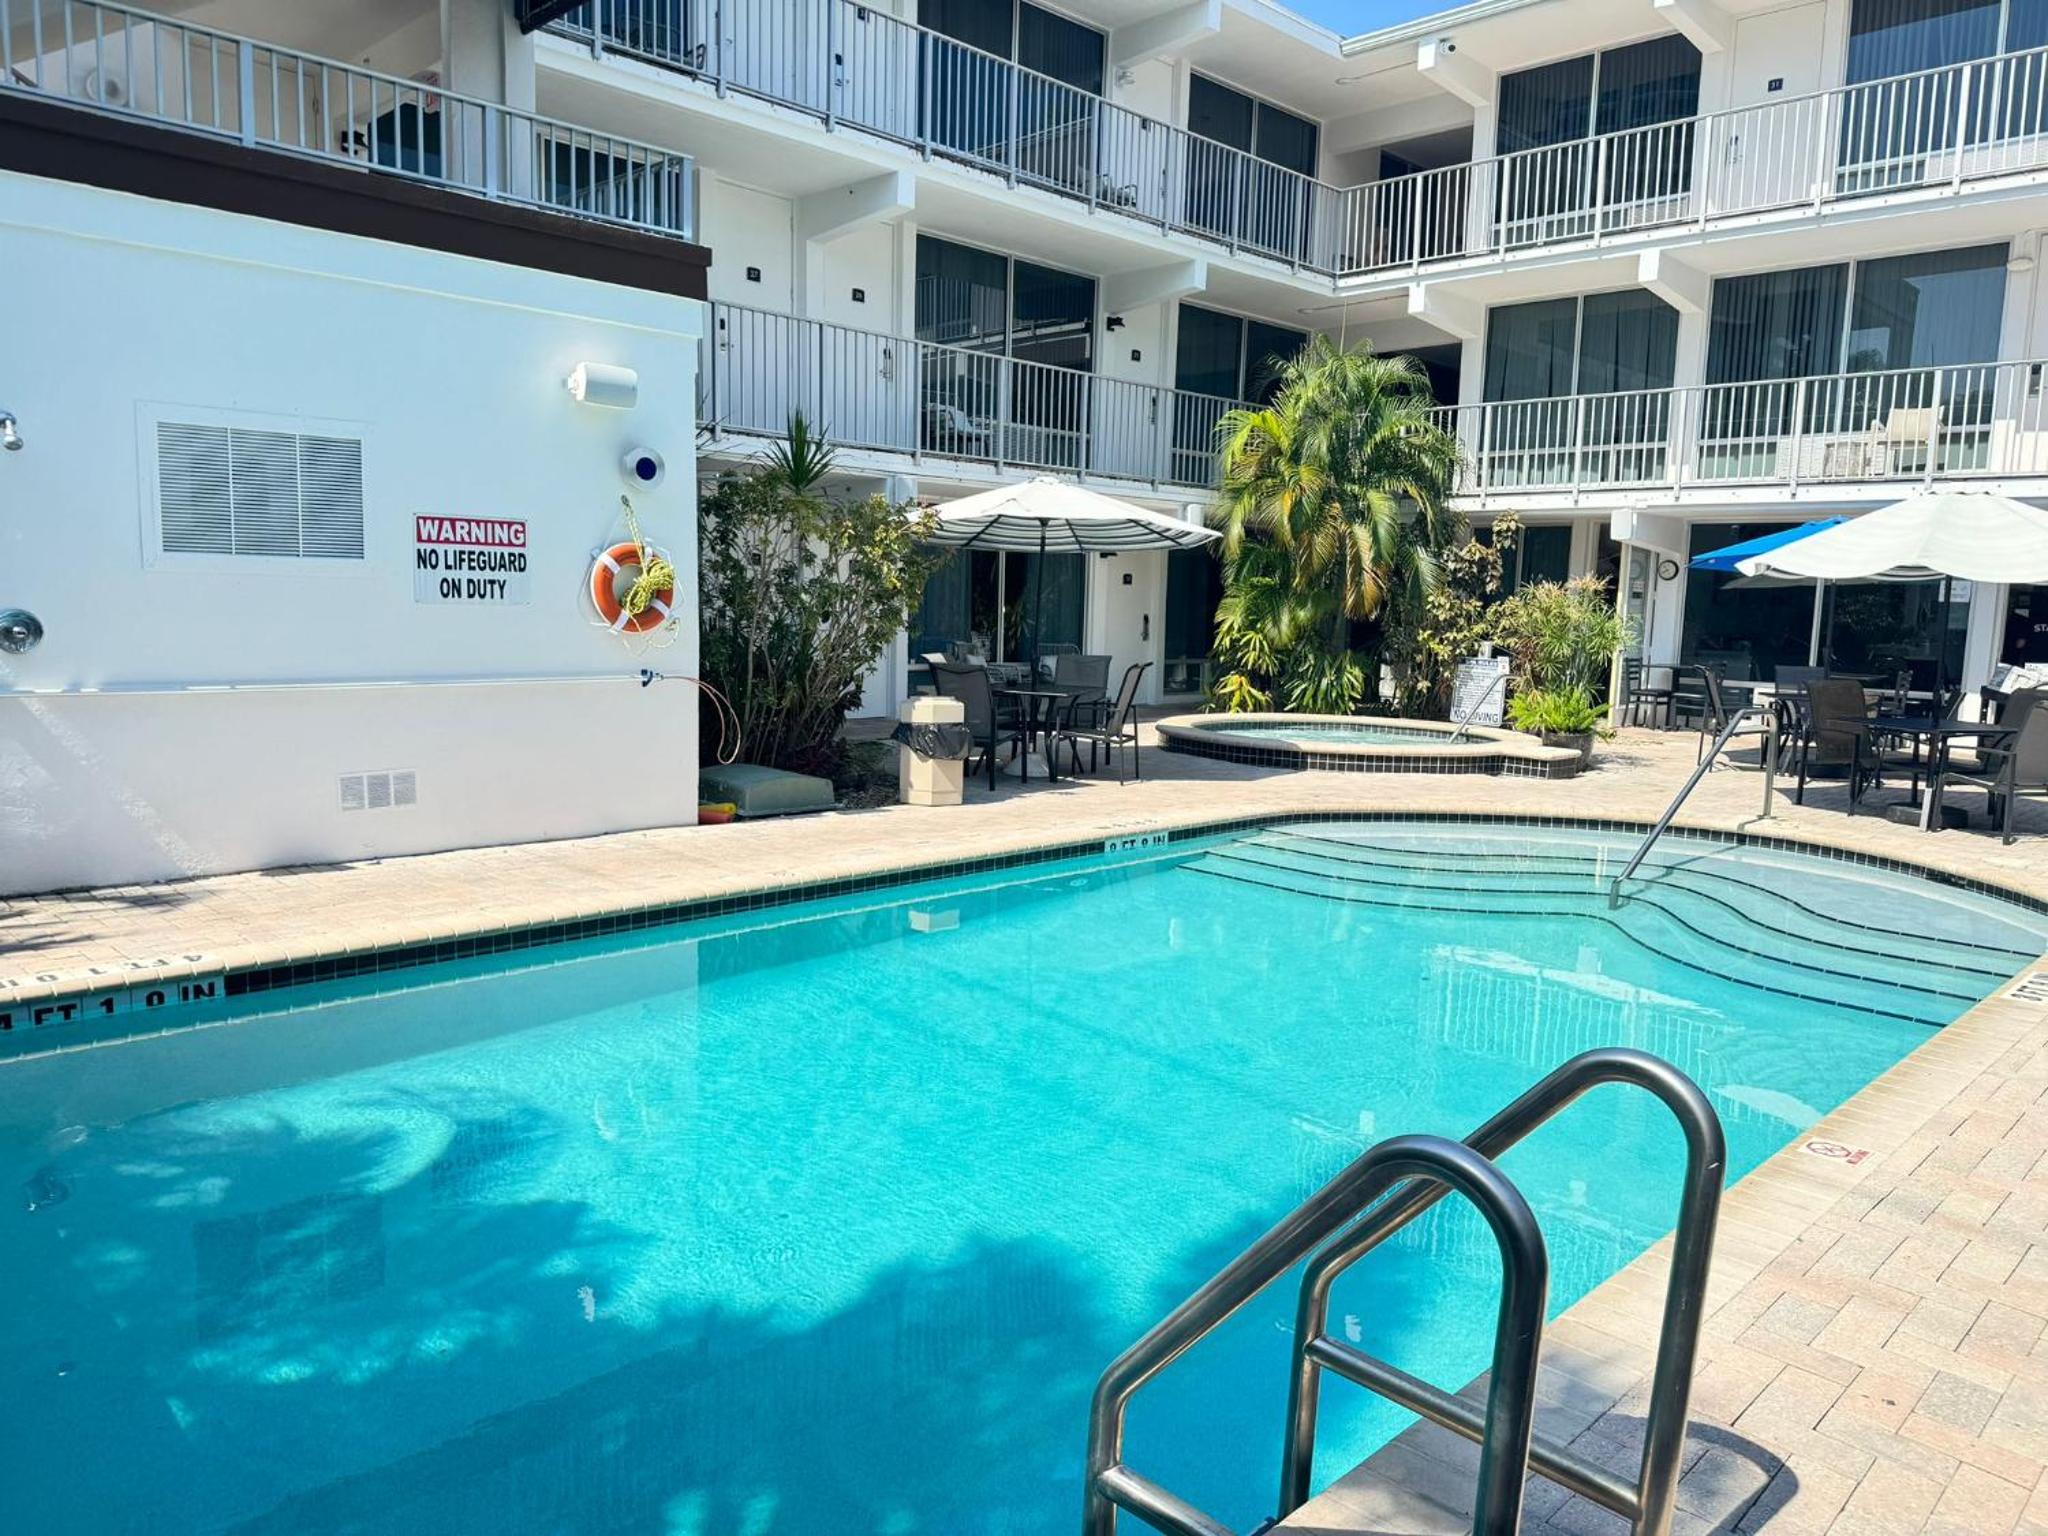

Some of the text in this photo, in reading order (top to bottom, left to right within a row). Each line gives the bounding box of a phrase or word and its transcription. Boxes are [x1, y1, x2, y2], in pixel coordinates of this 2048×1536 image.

[419, 519, 525, 545] WARNING
[417, 548, 527, 572] NO LIFEGUARD
[440, 578, 507, 600] ON DUTY
[2033, 624, 2048, 632] ST
[181, 981, 215, 1002] IN
